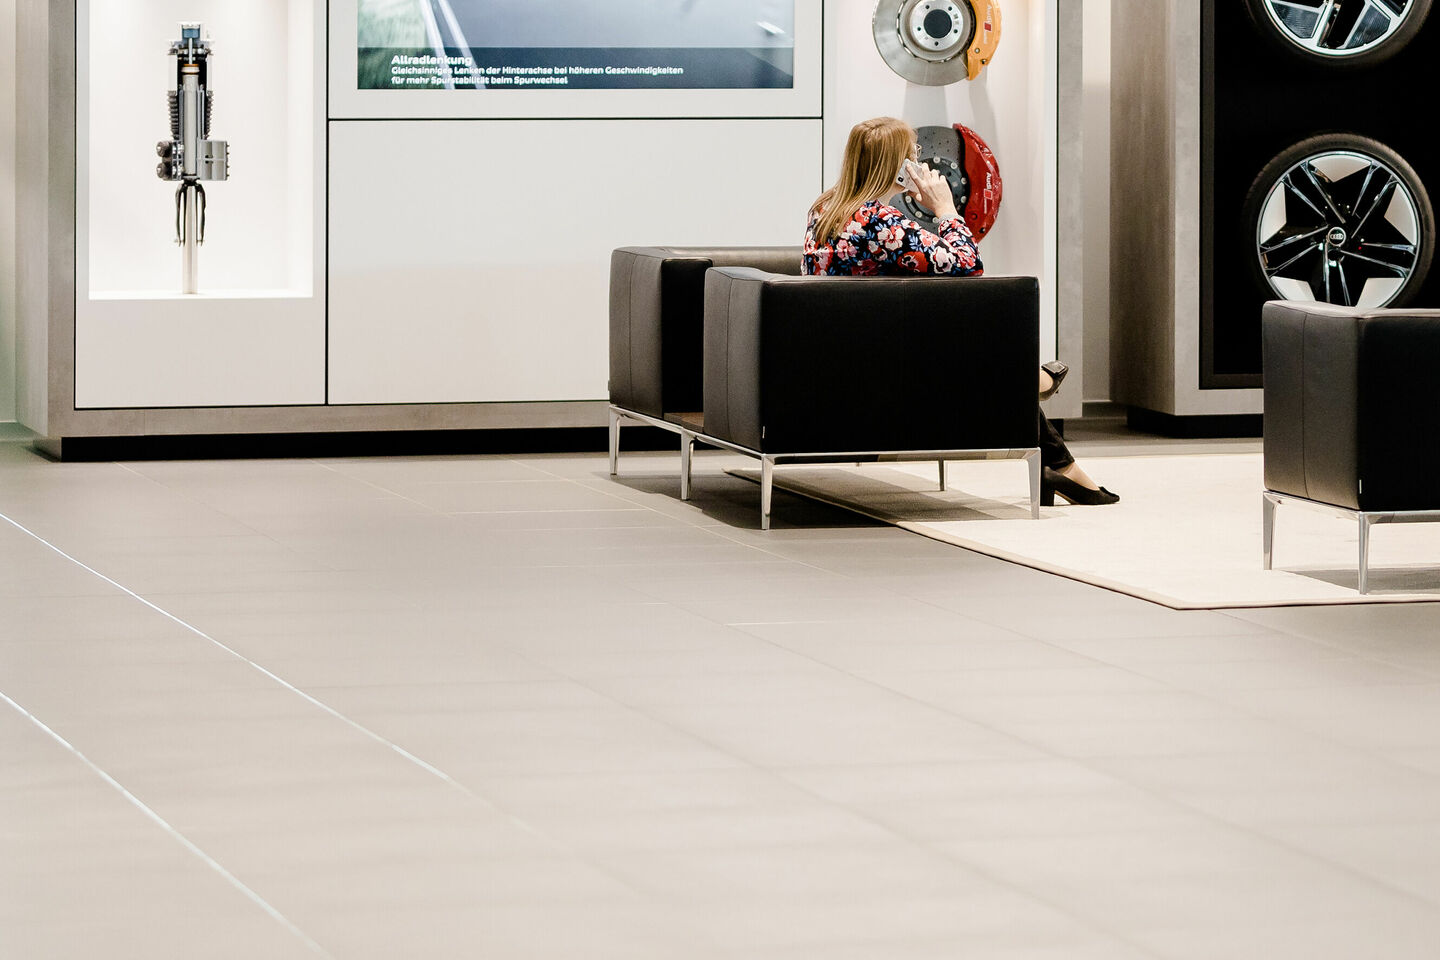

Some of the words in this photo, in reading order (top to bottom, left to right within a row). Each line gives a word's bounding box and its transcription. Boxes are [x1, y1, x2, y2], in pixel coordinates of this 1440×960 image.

[391, 54, 473, 67] Allradlenkung
[391, 66, 453, 76] Gleichsinniges
[454, 66, 485, 75] Lenken
[485, 66, 502, 75] der
[502, 66, 553, 75] Hinterachse
[553, 66, 567, 75] bei
[568, 66, 604, 75] höheren
[604, 66, 684, 76] Geschwindigkeiten
[391, 76, 405, 85] für
[406, 76, 429, 85] mehr
[430, 76, 490, 86] Spurstabilität
[490, 76, 513, 85] beim
[513, 75, 569, 86] Spurwechsel
